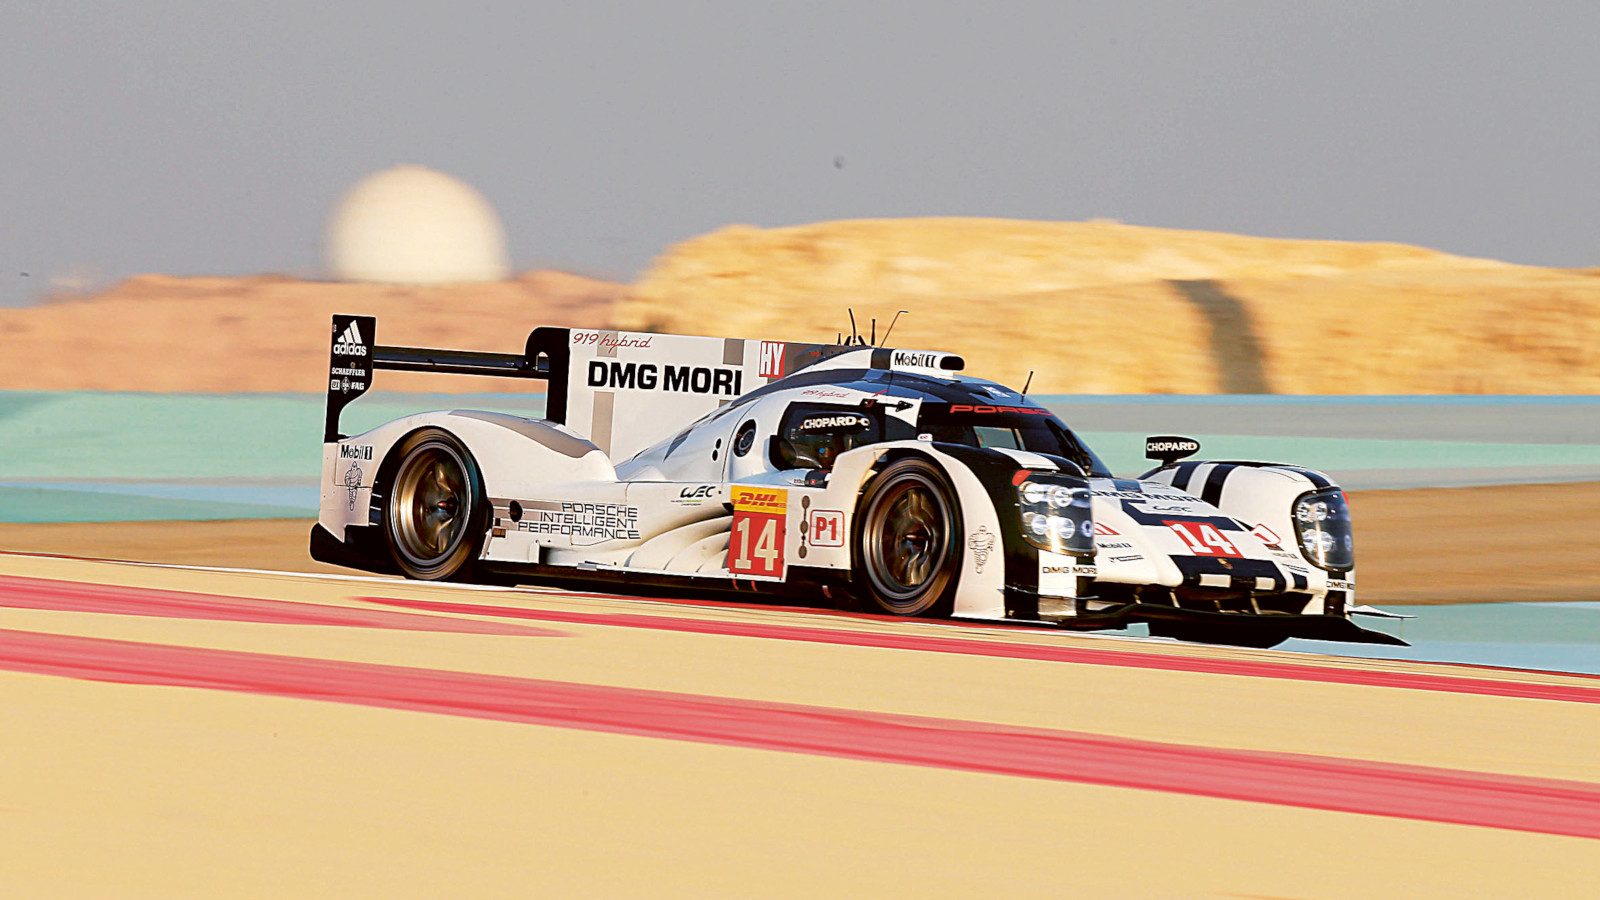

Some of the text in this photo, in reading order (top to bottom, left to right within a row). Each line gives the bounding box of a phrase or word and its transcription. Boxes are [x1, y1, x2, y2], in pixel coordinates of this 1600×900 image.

[333, 342, 367, 357] adidas
[573, 332, 652, 354] 919 hybrid
[760, 341, 785, 376] HY
[895, 352, 925, 367] Mobil
[331, 367, 365, 377] SCHAEFFLER
[588, 361, 742, 396] DMG MORI
[351, 382, 364, 390] FAG
[340, 444, 364, 459] Mobil
[1147, 441, 1198, 452] CHOPARD
[680, 485, 716, 498] WEC
[739, 492, 777, 507] DHL
[562, 502, 638, 517] PORSCHE
[540, 511, 637, 528] INTELLIGENT
[518, 521, 641, 540] PERFORMANCE
[815, 517, 838, 541] P1
[735, 517, 779, 571] 14
[1172, 523, 1237, 555] 14
[1042, 566, 1069, 574] DMG
